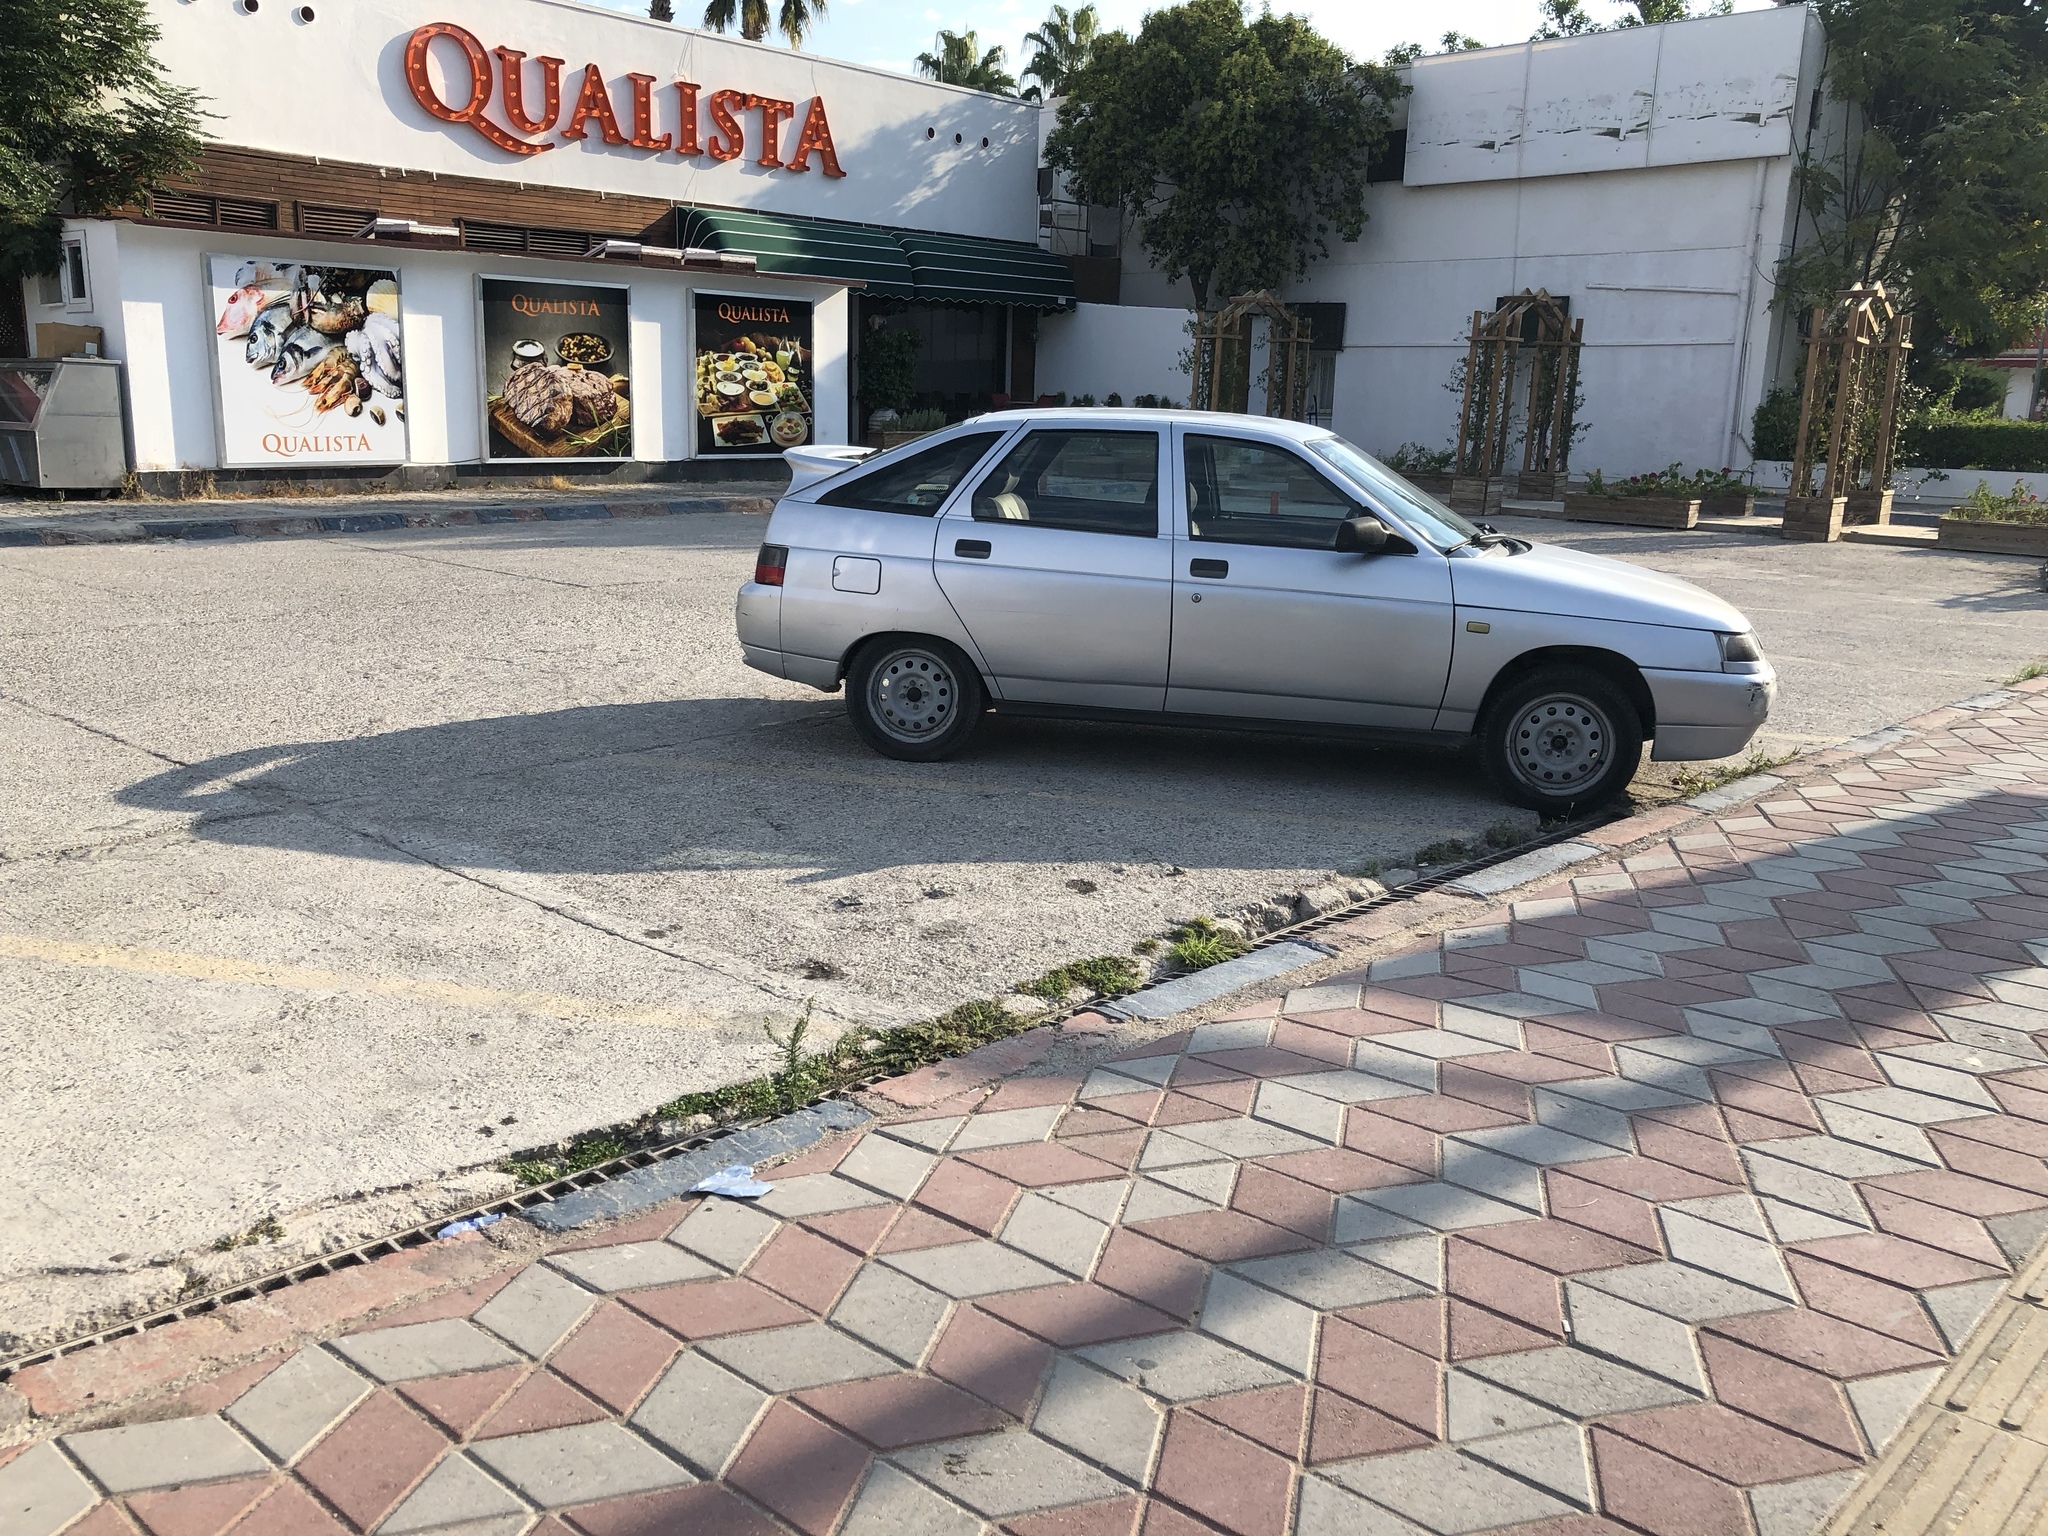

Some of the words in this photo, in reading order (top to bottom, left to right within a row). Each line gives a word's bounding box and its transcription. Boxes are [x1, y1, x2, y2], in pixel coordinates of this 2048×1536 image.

[404, 22, 847, 178] QUALISTA
[512, 294, 600, 317] QUALISTA
[718, 302, 790, 324] QUALISTA
[262, 433, 372, 457] QUALISTA
